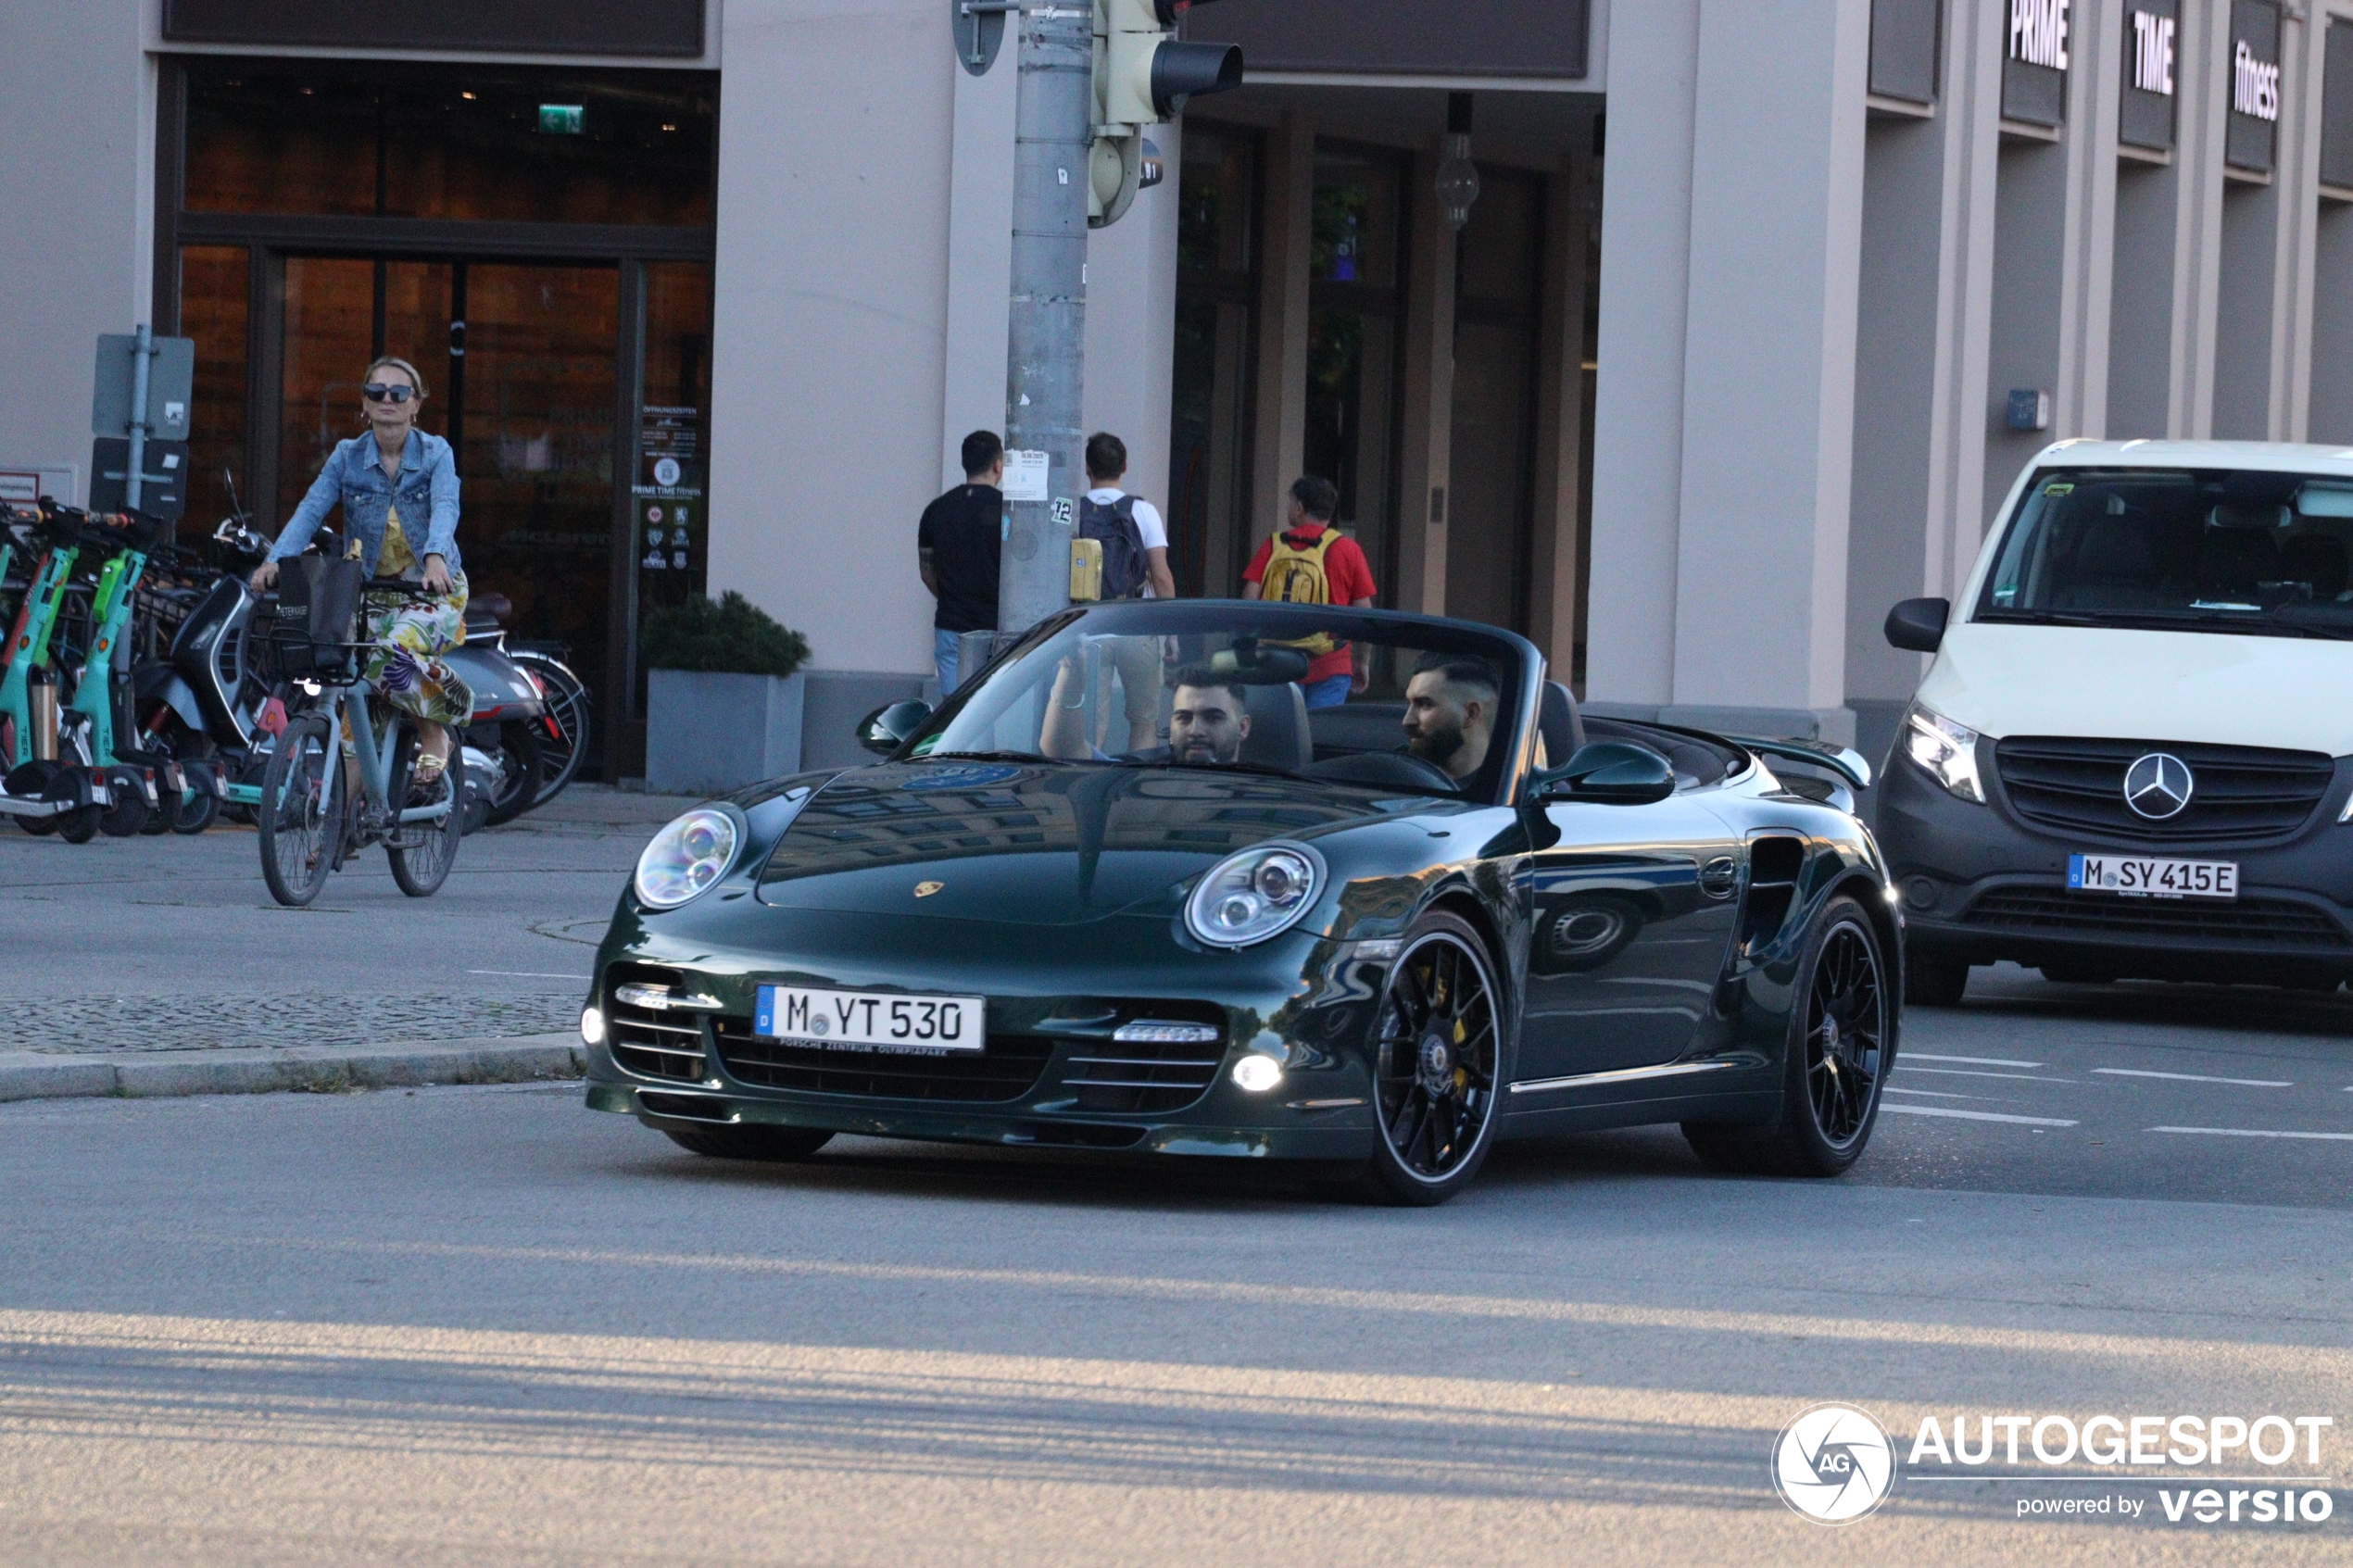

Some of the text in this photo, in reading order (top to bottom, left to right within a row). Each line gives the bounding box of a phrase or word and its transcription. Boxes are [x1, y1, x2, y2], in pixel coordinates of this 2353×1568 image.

[2009, 0, 2279, 121] PRIME TIME fitness
[632, 485, 701, 496] PRIME TIME fitness
[2084, 859, 2102, 885] M
[787, 994, 808, 1032] M
[780, 1037, 949, 1057] PORSCHE ZENTRUM OLYMPIAPARK
